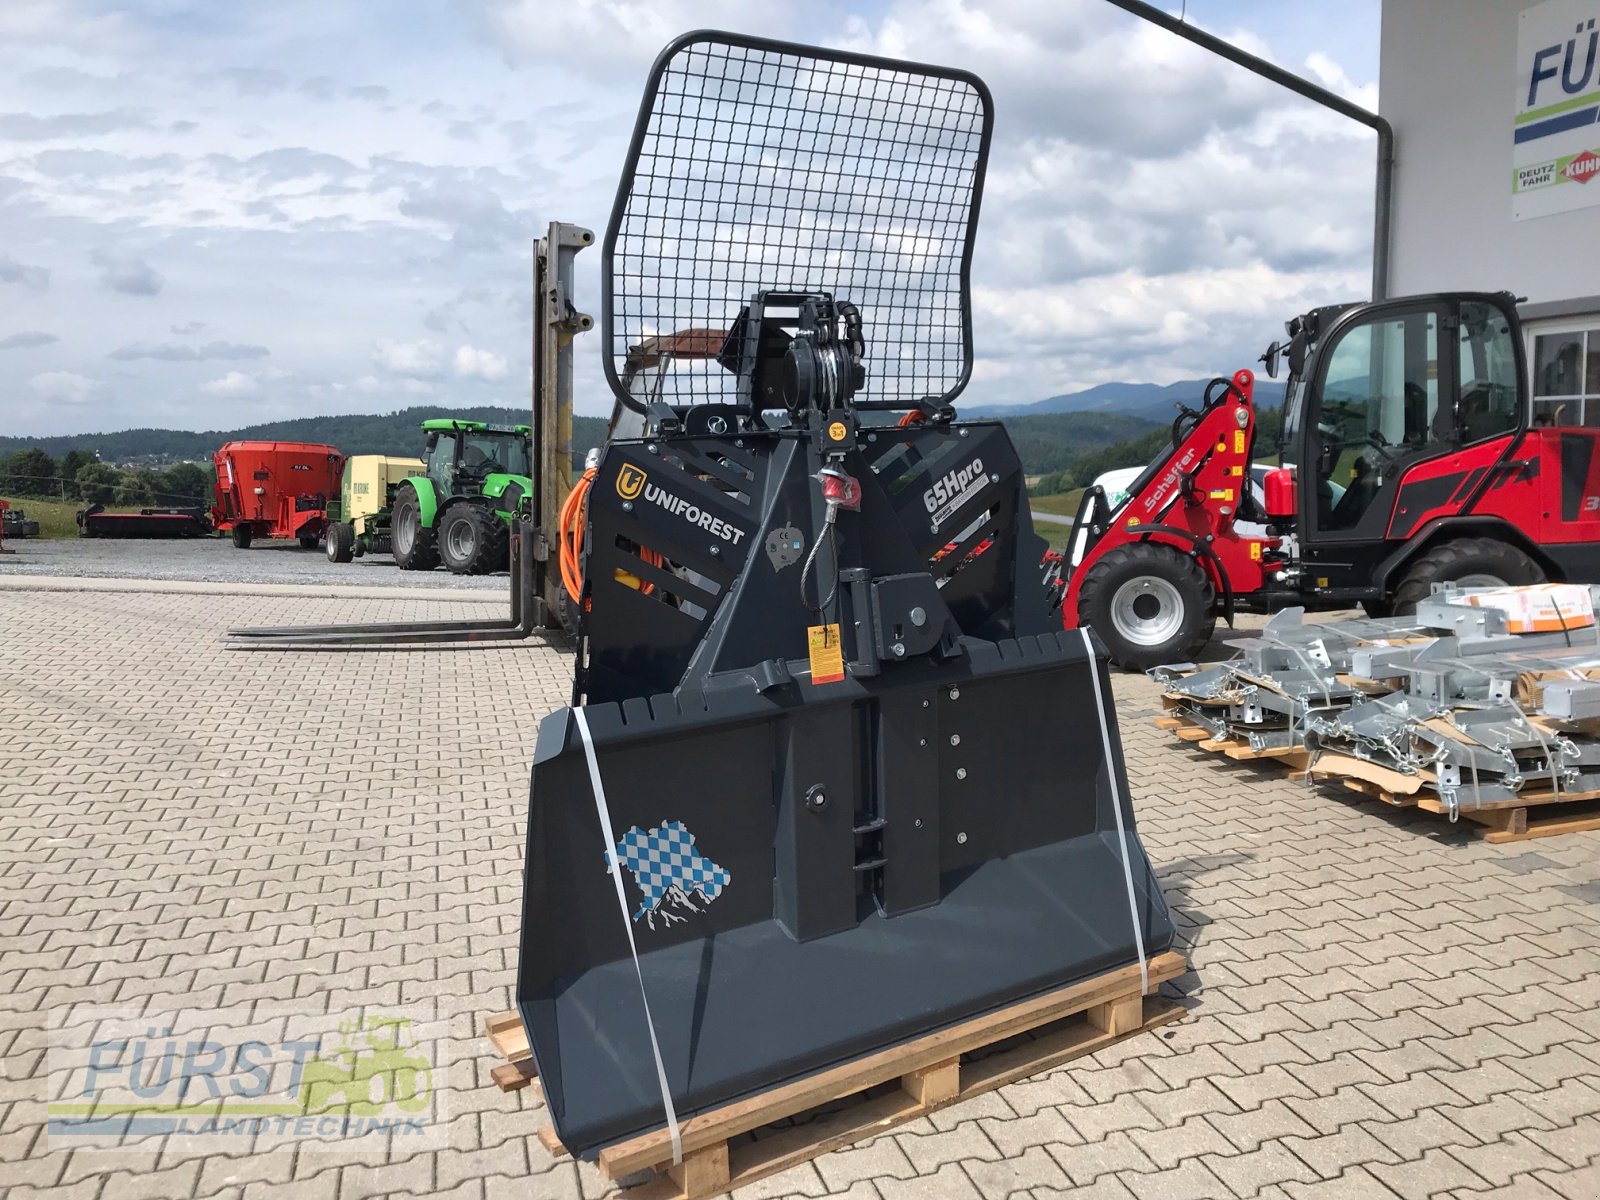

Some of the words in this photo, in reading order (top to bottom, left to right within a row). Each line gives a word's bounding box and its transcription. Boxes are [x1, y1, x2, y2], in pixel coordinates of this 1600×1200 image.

[1527, 18, 1600, 107] FÜ
[1519, 164, 1555, 179] DEUTZ
[1522, 173, 1551, 187] FAHR
[923, 458, 984, 513] 65Hpro
[1144, 448, 1195, 513] Schäffer
[1584, 496, 1600, 511] 3
[644, 483, 745, 545] UNIFOREST
